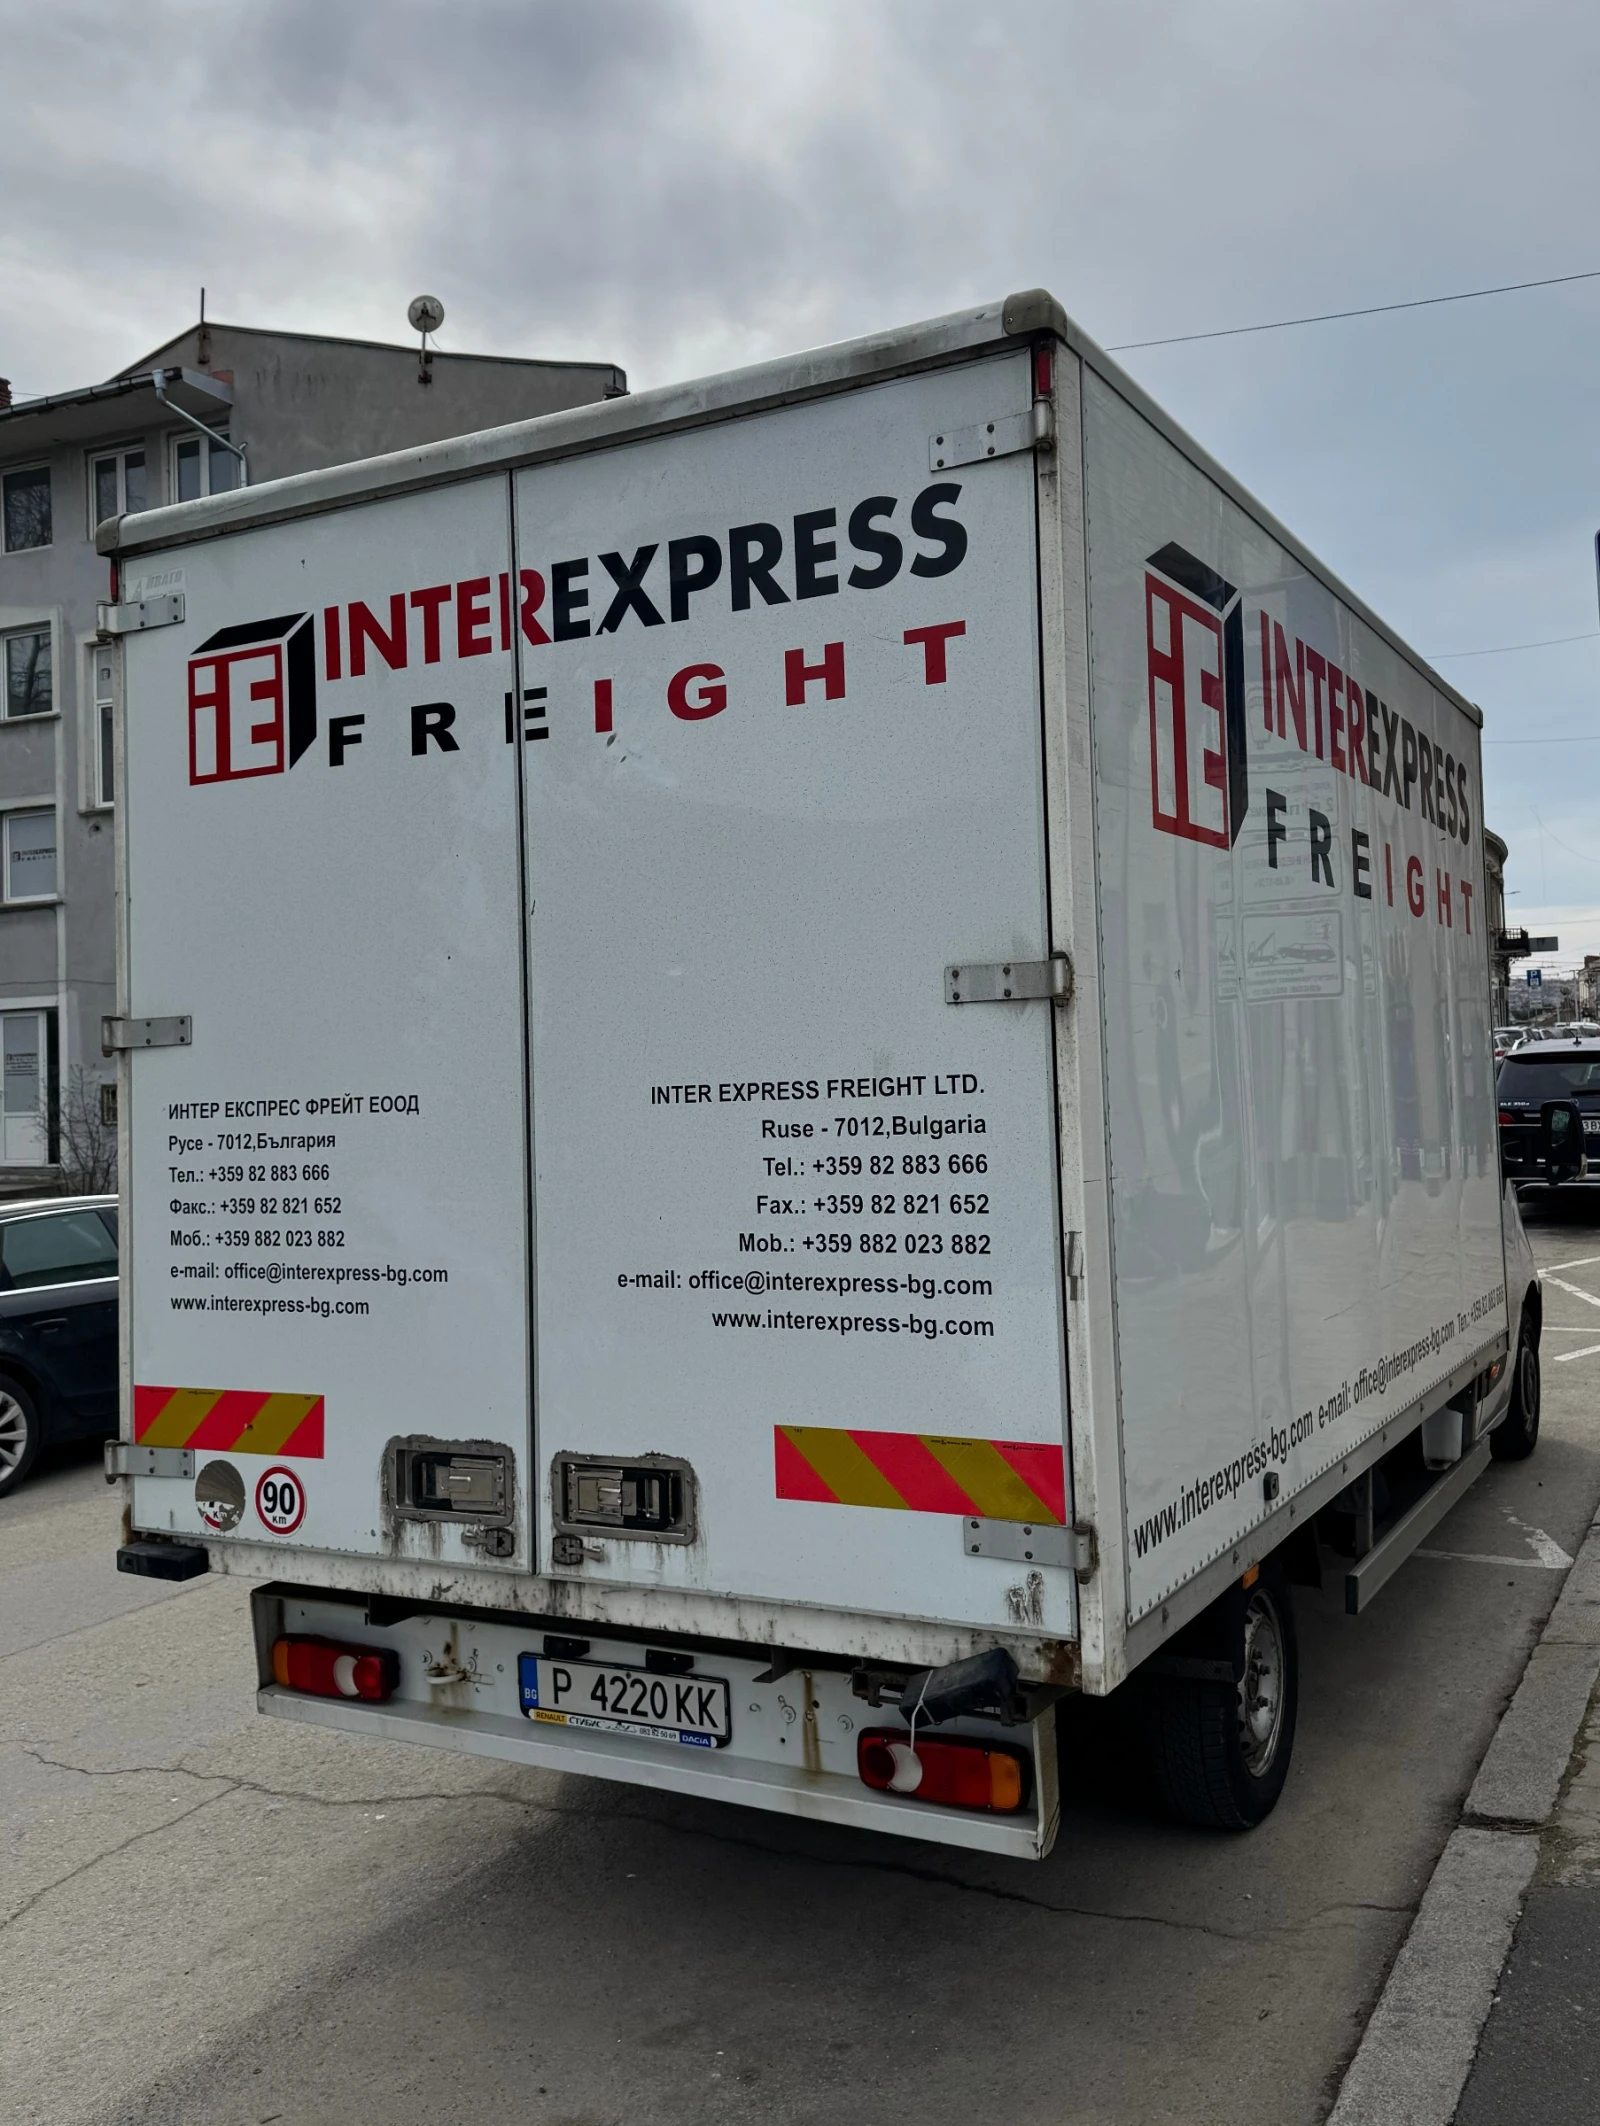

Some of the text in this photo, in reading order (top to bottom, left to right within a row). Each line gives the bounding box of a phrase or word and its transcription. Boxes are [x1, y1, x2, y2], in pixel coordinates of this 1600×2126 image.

[325, 482, 966, 678] INTEREXPRESS
[327, 620, 966, 767] FREIGHT
[1260, 609, 1470, 845] INTEREXPRESS
[1266, 788, 1472, 934] FREIGHT
[652, 1074, 984, 1104] INTER EXPRESS FREIGHT LTD.
[169, 1093, 419, 1120] ИНТЕР ЕКСПРЕС ФРЕЙТ ЕООД
[762, 1120, 814, 1138] Ruse
[835, 1114, 986, 1139] 7012,Bulgaria
[169, 1136, 203, 1155] Русе
[217, 1133, 335, 1152] 7012,България
[169, 1164, 329, 1183] Тел.: +359 82 883 666
[763, 1154, 988, 1176] Tel.: +359 82 883 666
[170, 1197, 341, 1214] Факс.: +359 82 821 652
[757, 1194, 989, 1214] Fax.: +359 82 821 652
[171, 1230, 345, 1247] Моб.: +359 882 023 882
[739, 1233, 991, 1254] Mob.: +359 882 023 882
[171, 1262, 448, 1286] e-mail: office@interexpress-bg.com
[618, 1270, 992, 1300] e-mail: office@interexpress-bg.com
[171, 1294, 369, 1318] www.interexpress-bg.com
[712, 1309, 994, 1340] www.interexpress-bg.com
[1134, 1409, 1313, 1558] www.interexpress-bg.com
[1319, 1382, 1351, 1429] e-mail:
[1354, 1320, 1454, 1404] office@interexpress-bg.com
[263, 1481, 295, 1515] 90
[524, 1687, 537, 1700] BG
[553, 1668, 718, 1728] P 4220 KK
[536, 1711, 565, 1723] RENAULT
